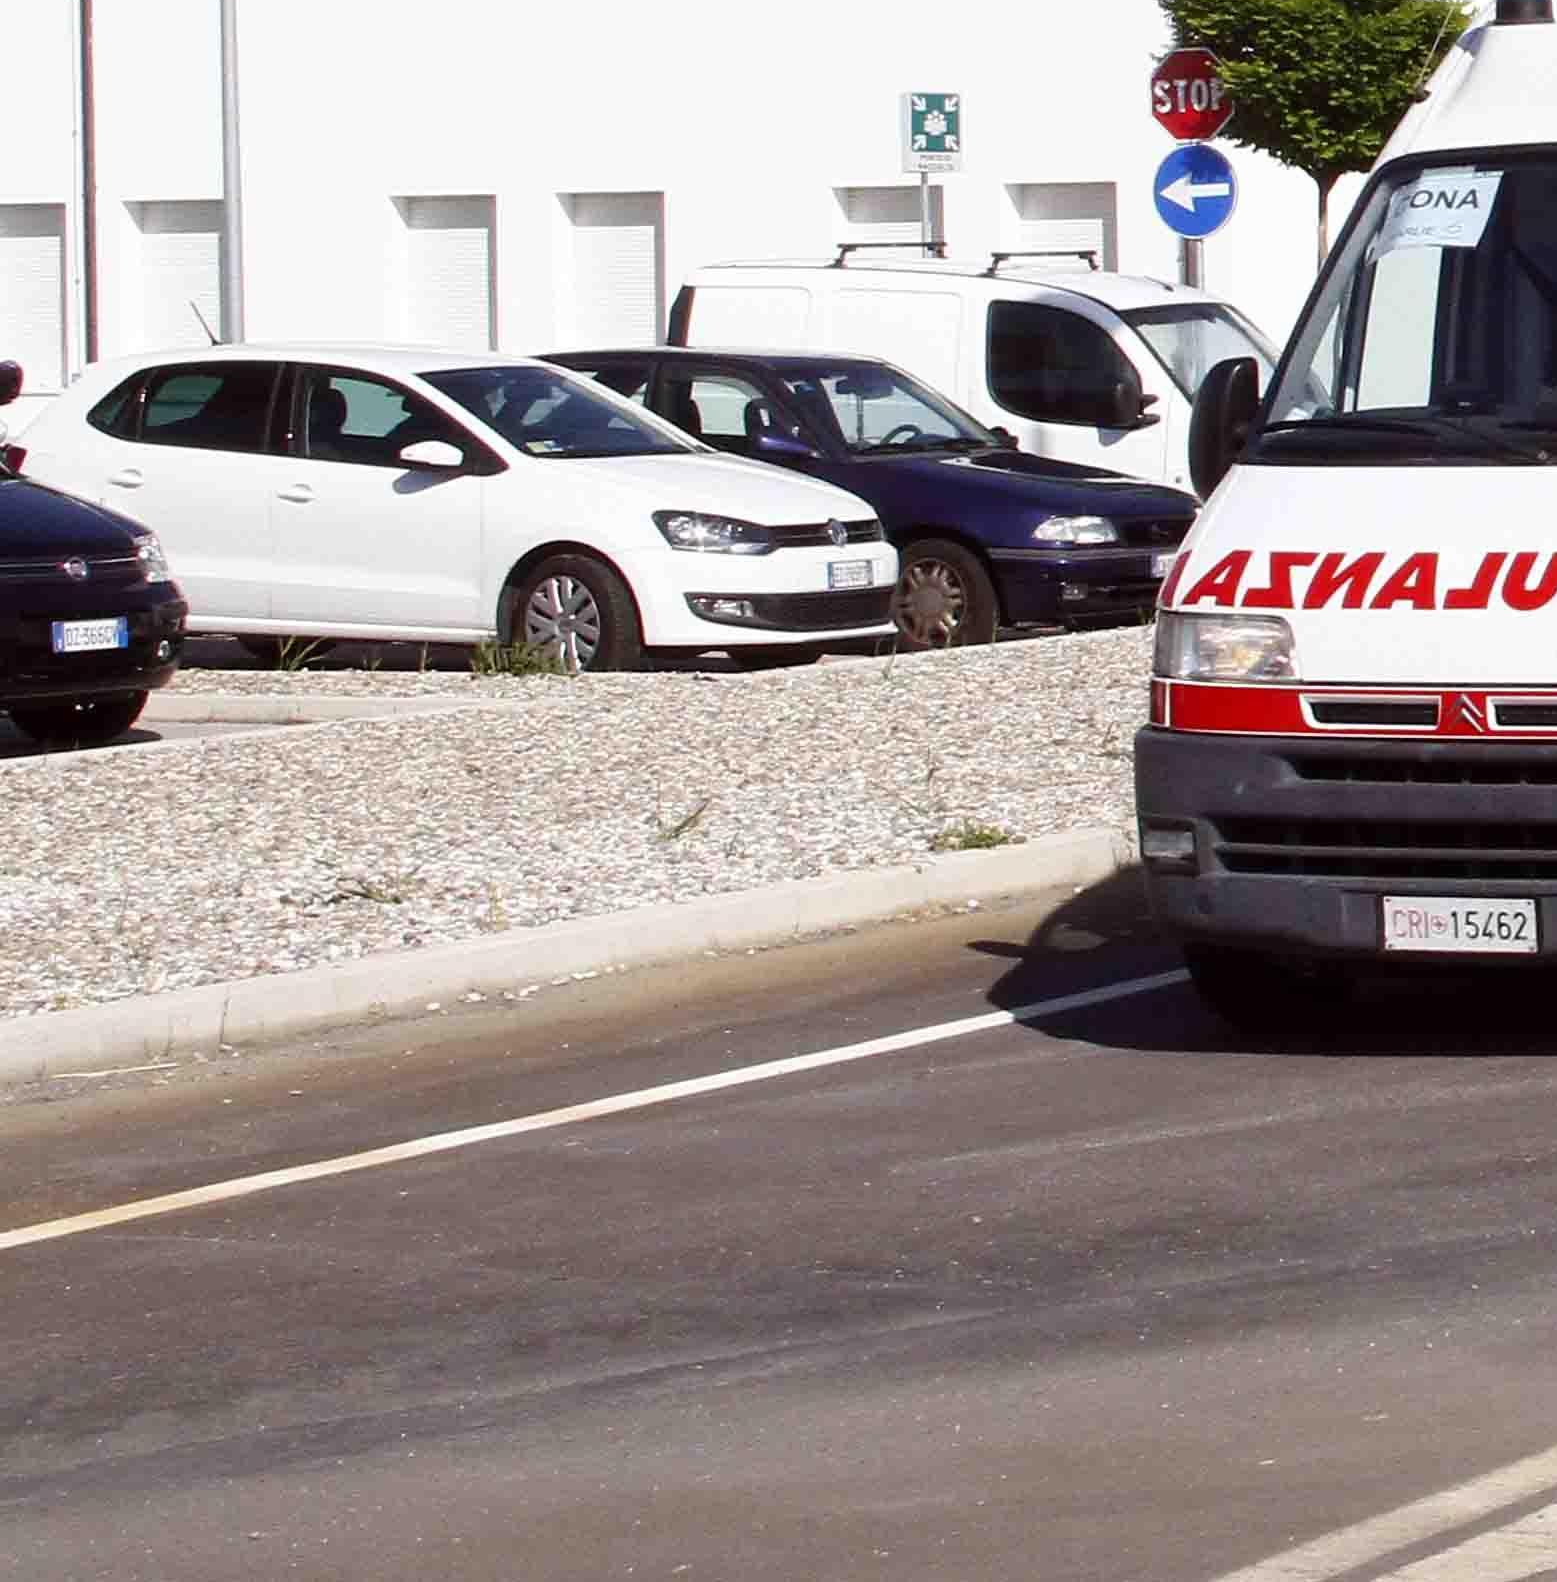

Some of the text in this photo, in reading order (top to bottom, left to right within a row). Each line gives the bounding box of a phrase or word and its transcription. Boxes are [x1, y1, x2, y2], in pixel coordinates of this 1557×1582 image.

[1153, 77, 1225, 114] STOP
[1392, 909, 1529, 941] CRI 15462
